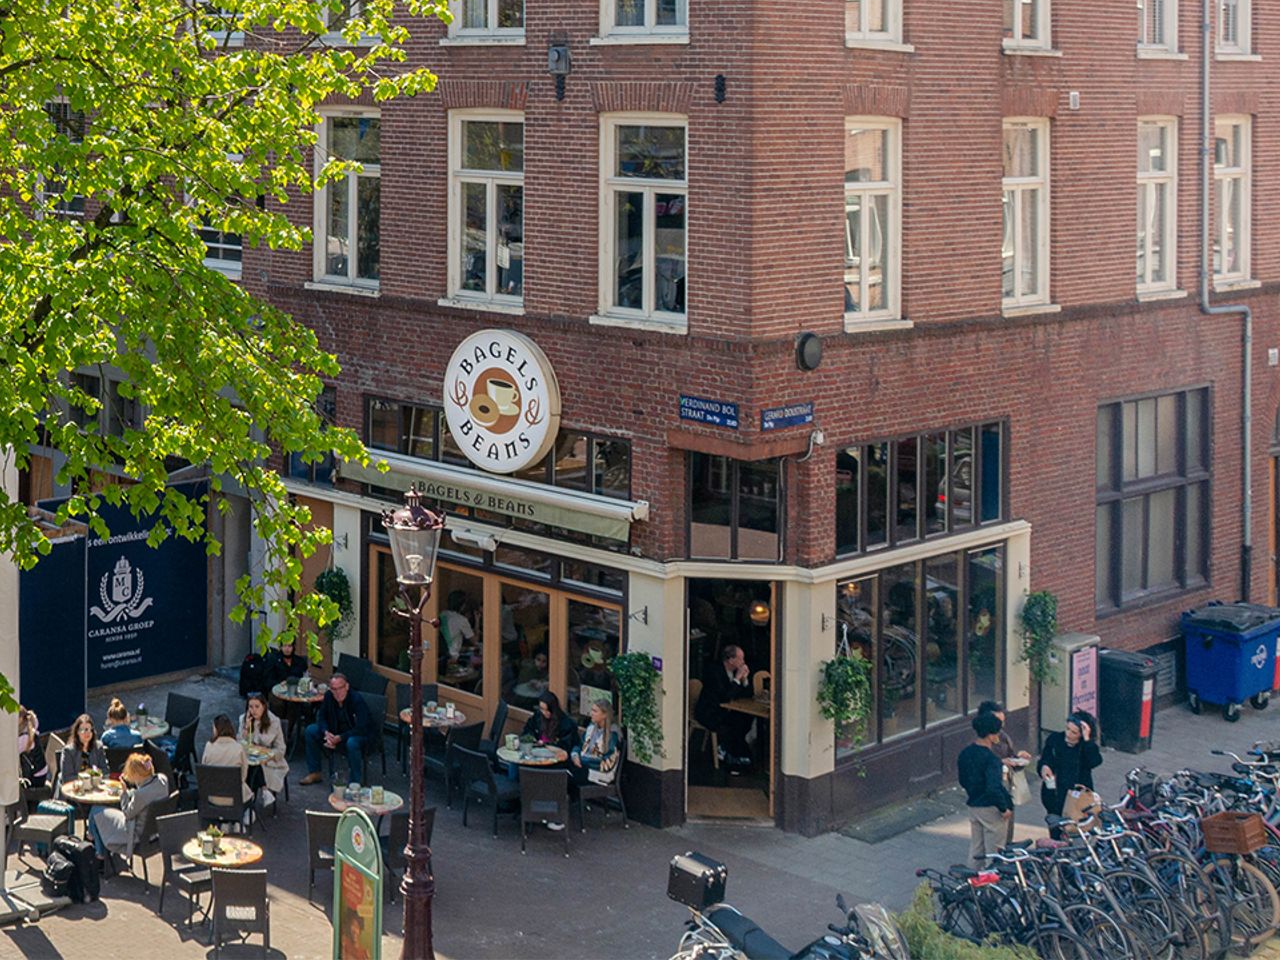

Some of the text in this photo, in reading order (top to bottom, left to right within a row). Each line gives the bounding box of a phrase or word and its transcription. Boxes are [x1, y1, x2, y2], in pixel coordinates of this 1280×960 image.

[460, 341, 538, 391] BAGELS
[681, 407, 705, 420] STRAAT
[721, 404, 736, 417] BOL
[459, 420, 531, 461] BEANS
[419, 480, 535, 517] BAGELS & BEANS
[115, 575, 126, 588] M
[88, 620, 155, 638] CARANSA GROEP
